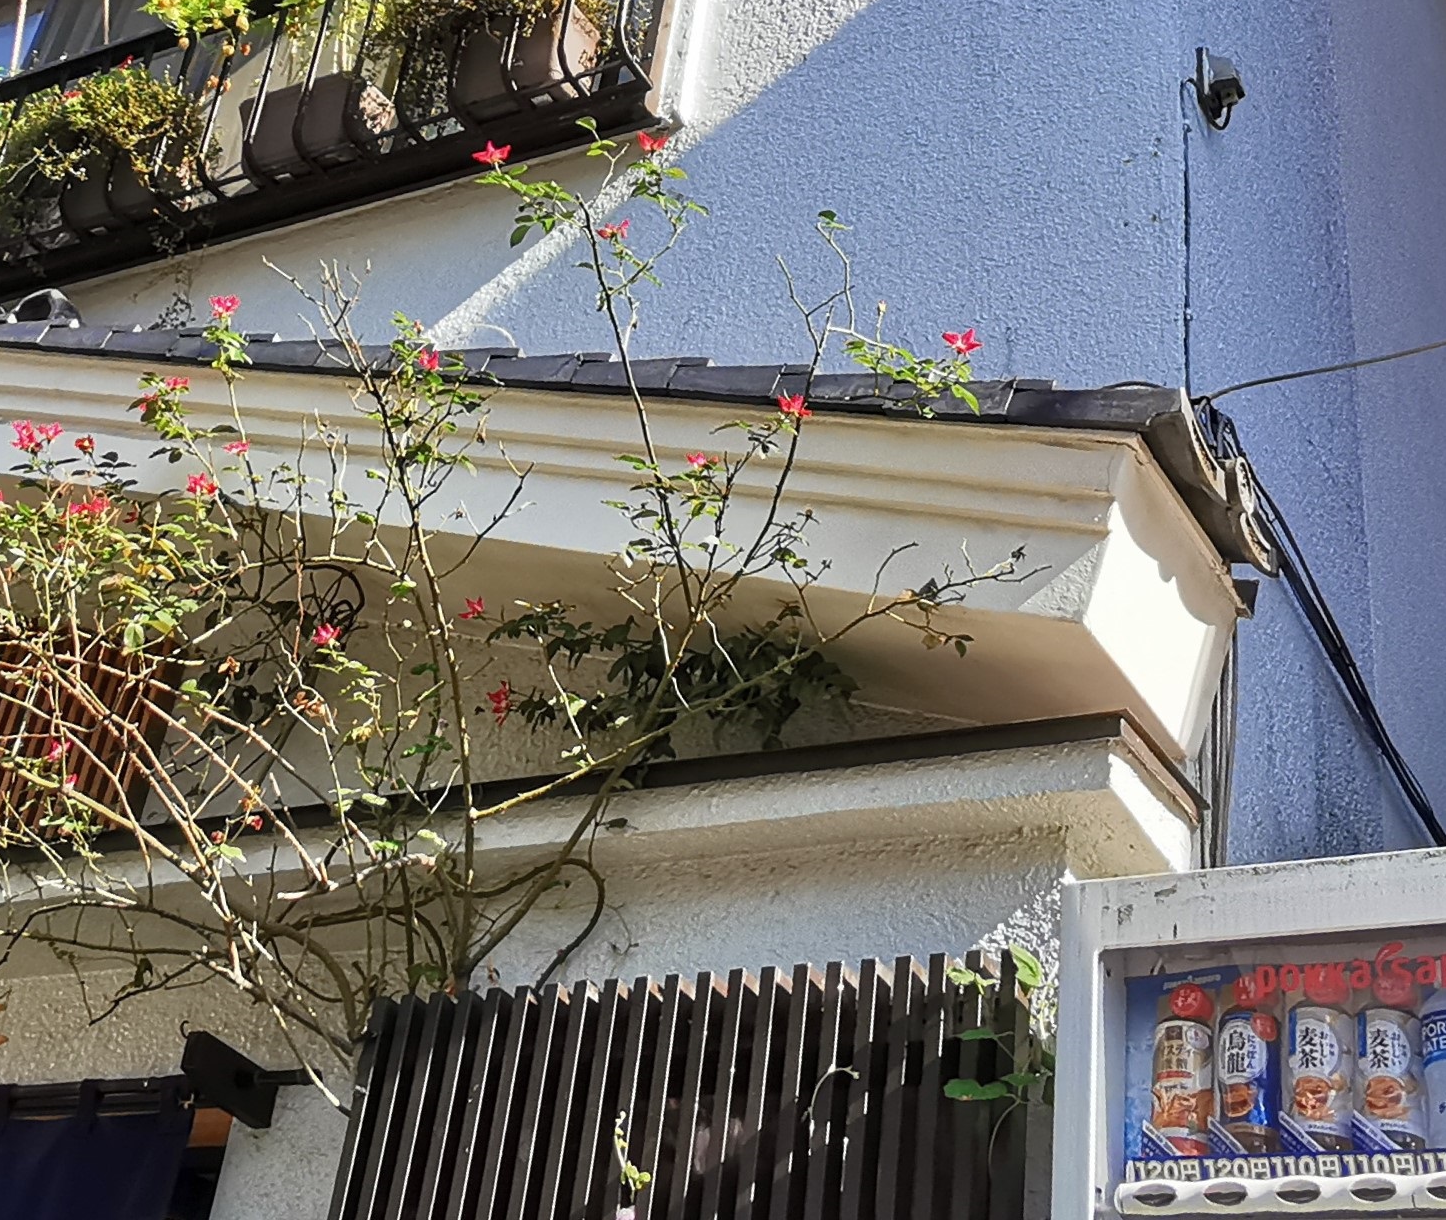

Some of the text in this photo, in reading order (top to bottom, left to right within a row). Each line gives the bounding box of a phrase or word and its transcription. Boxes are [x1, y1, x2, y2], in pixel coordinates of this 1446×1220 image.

[1298, 1026, 1319, 1068] 麦茶
[1369, 1028, 1390, 1068] 麦茶
[1136, 1159, 1201, 1181] 120円
[1204, 1157, 1270, 1180] 120円
[1271, 1154, 1341, 1178] 110円
[1343, 1152, 1415, 1176] 110円
